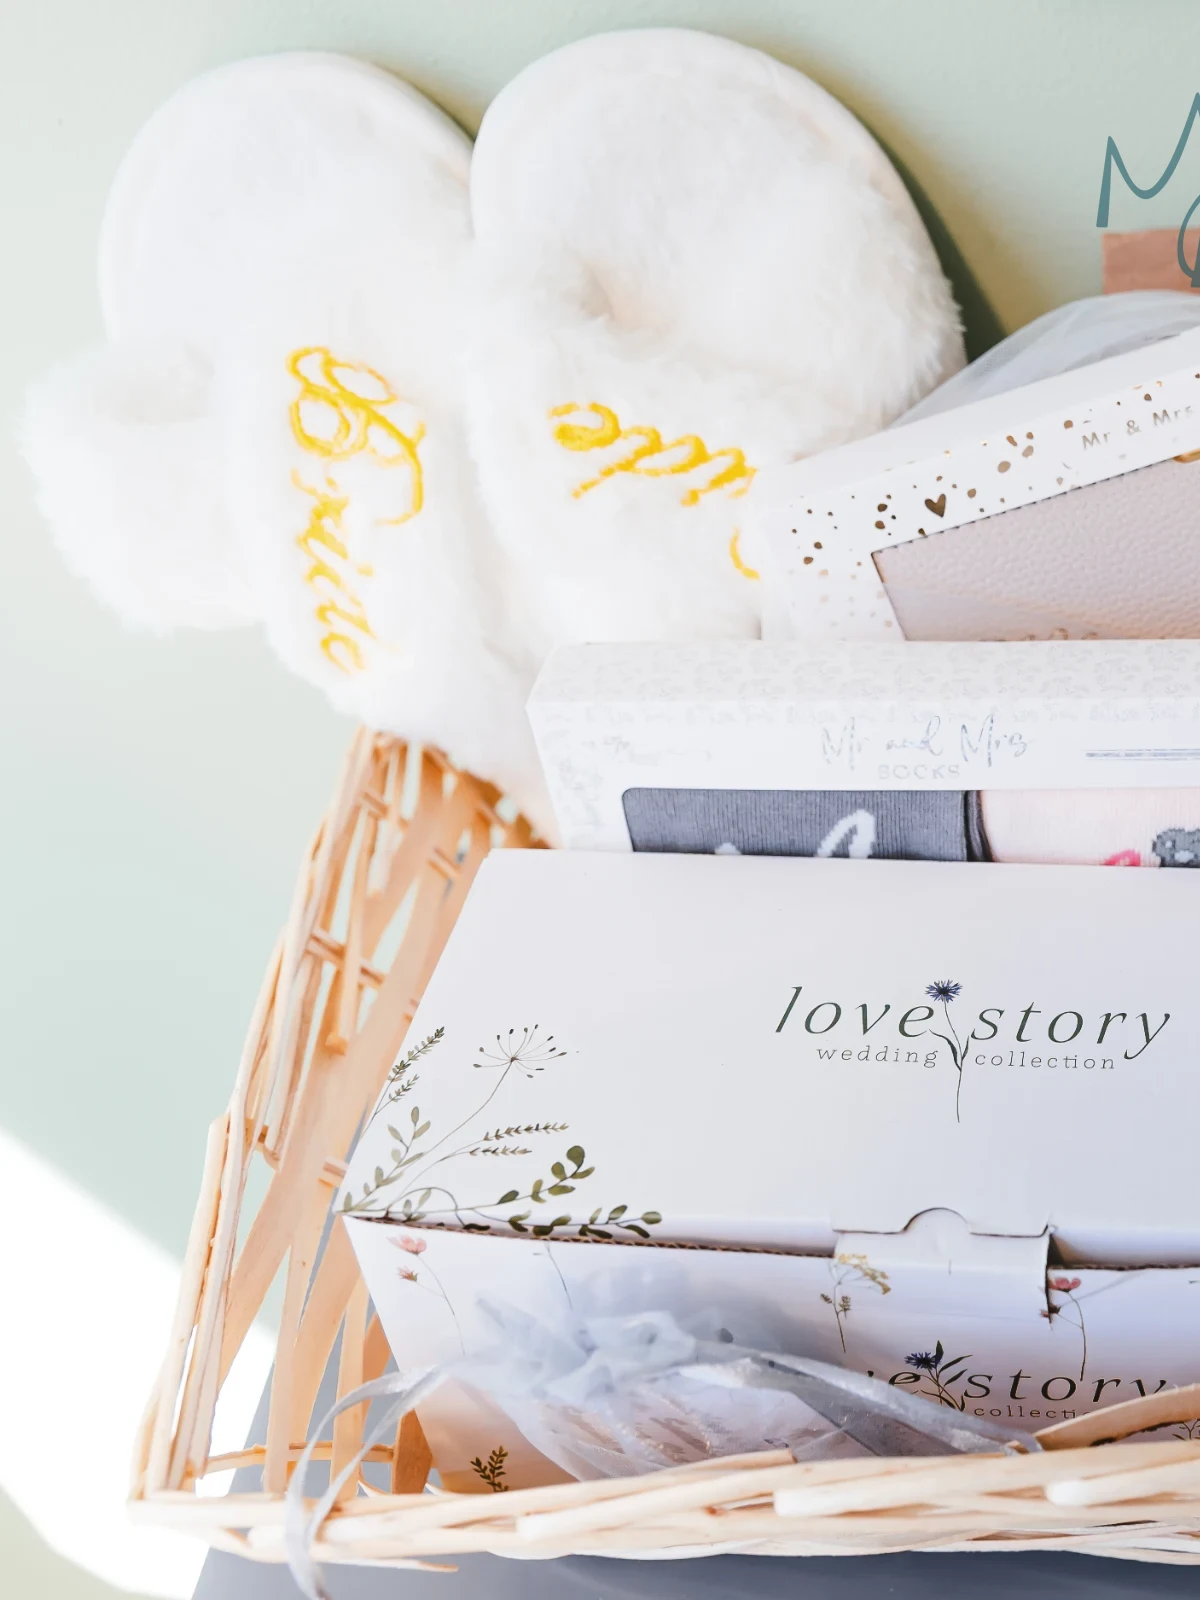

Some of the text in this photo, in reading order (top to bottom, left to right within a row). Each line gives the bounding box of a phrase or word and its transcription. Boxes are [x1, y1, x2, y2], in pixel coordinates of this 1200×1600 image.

[1081, 430, 1112, 451] Mr
[1126, 419, 1142, 435] &
[1152, 404, 1194, 428] Mrs
[821, 710, 1034, 772] Mr and Mrs
[774, 985, 1171, 1061] love story
[816, 1045, 1116, 1071] wedding collection
[974, 1404, 1091, 1419] collecti
